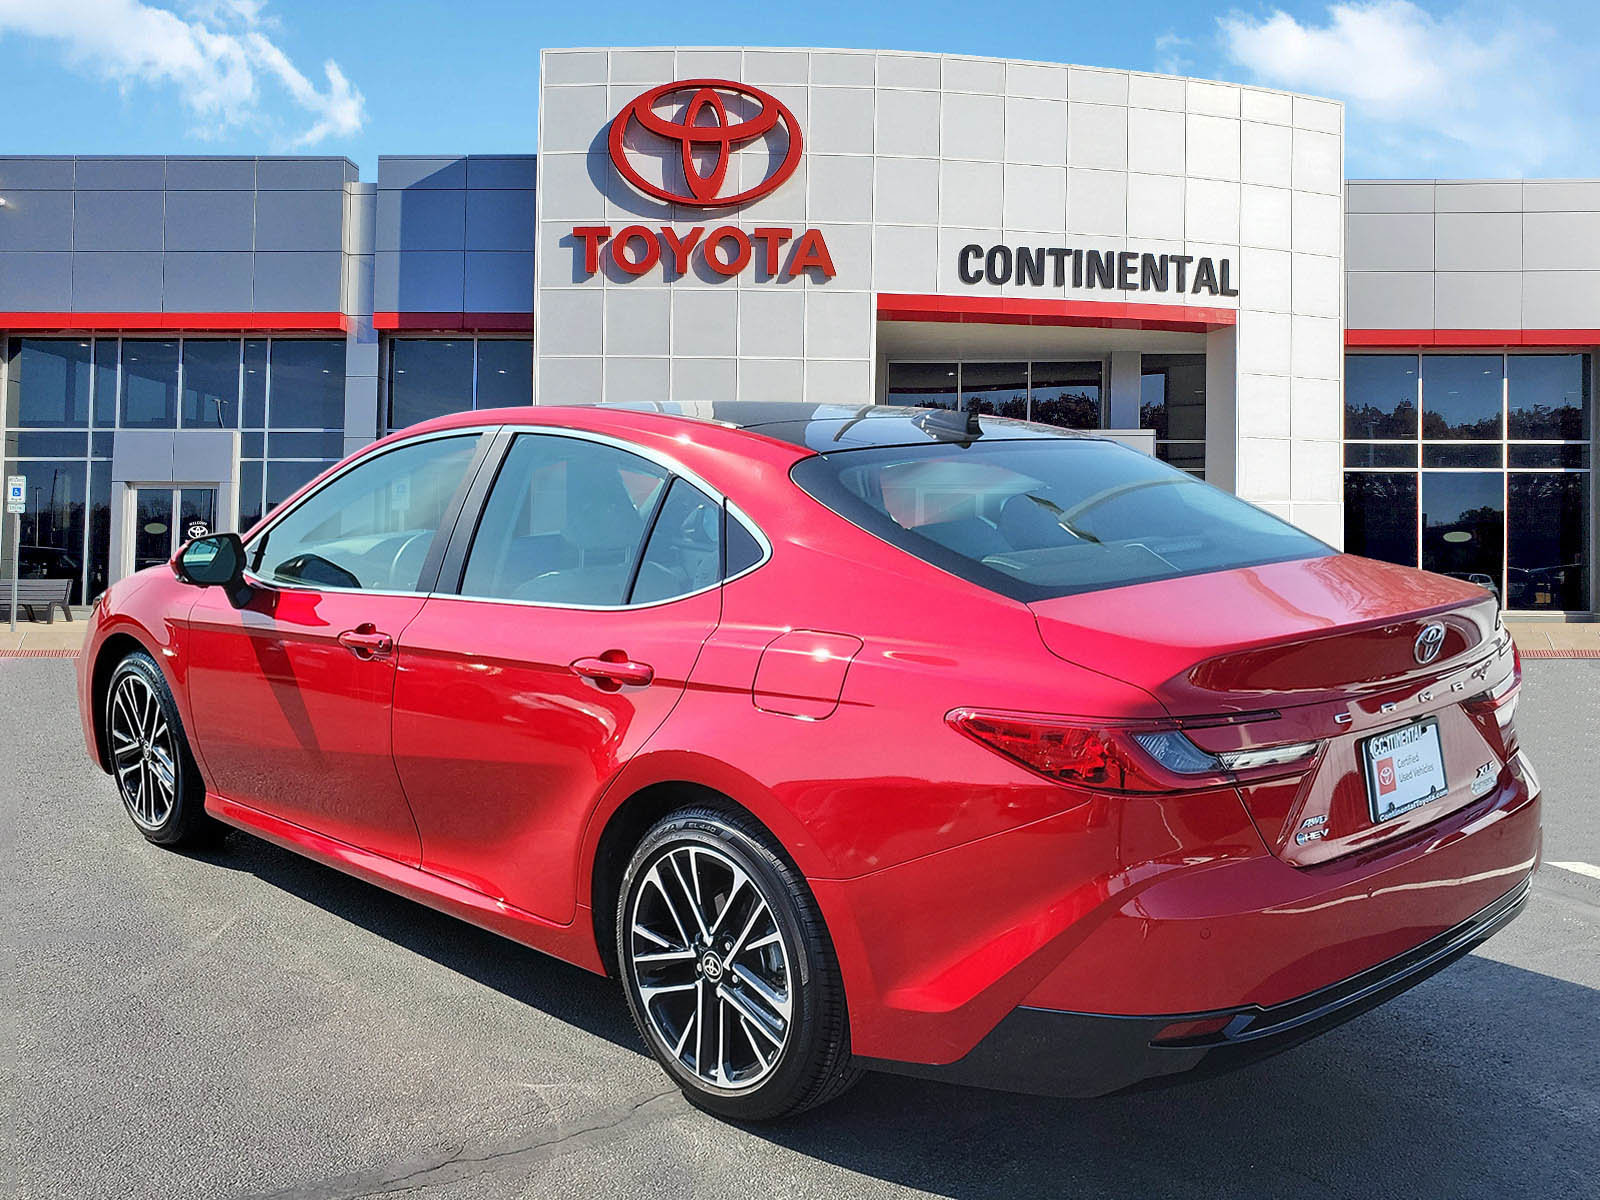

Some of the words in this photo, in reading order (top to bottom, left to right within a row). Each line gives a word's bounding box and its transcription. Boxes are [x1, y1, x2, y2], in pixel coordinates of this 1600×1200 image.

[572, 225, 837, 277] TOYOTA
[958, 244, 1239, 297] CONTINENTAL
[1300, 815, 1328, 829] AWD
[1304, 828, 1329, 842] HEV
